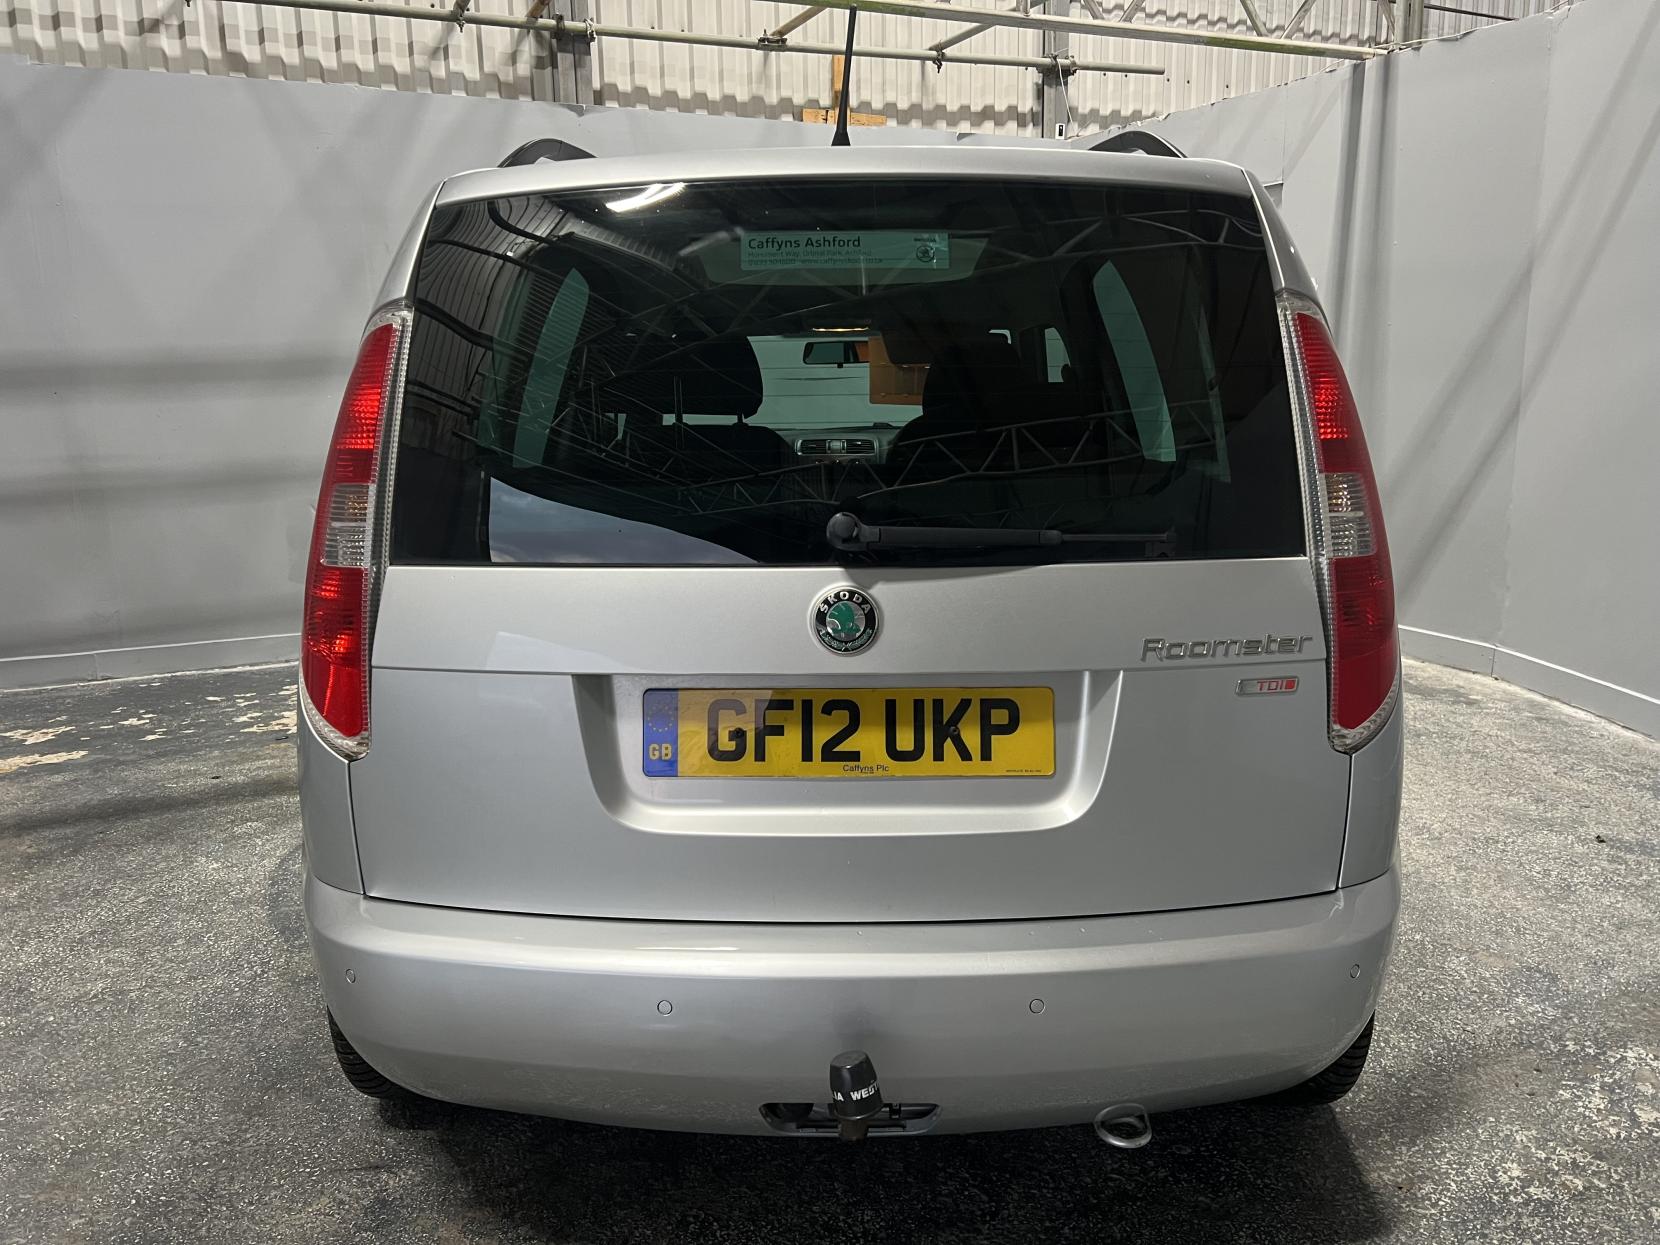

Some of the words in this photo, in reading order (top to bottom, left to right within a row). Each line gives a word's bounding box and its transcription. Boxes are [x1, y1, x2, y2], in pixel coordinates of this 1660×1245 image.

[748, 237, 800, 251] Caffyns
[805, 236, 861, 248] Ashford
[1140, 633, 1313, 662] Roomster
[707, 698, 861, 763] GF12
[885, 698, 1021, 762] UKP
[649, 743, 672, 761] GB
[842, 764, 874, 773] Caffyns
